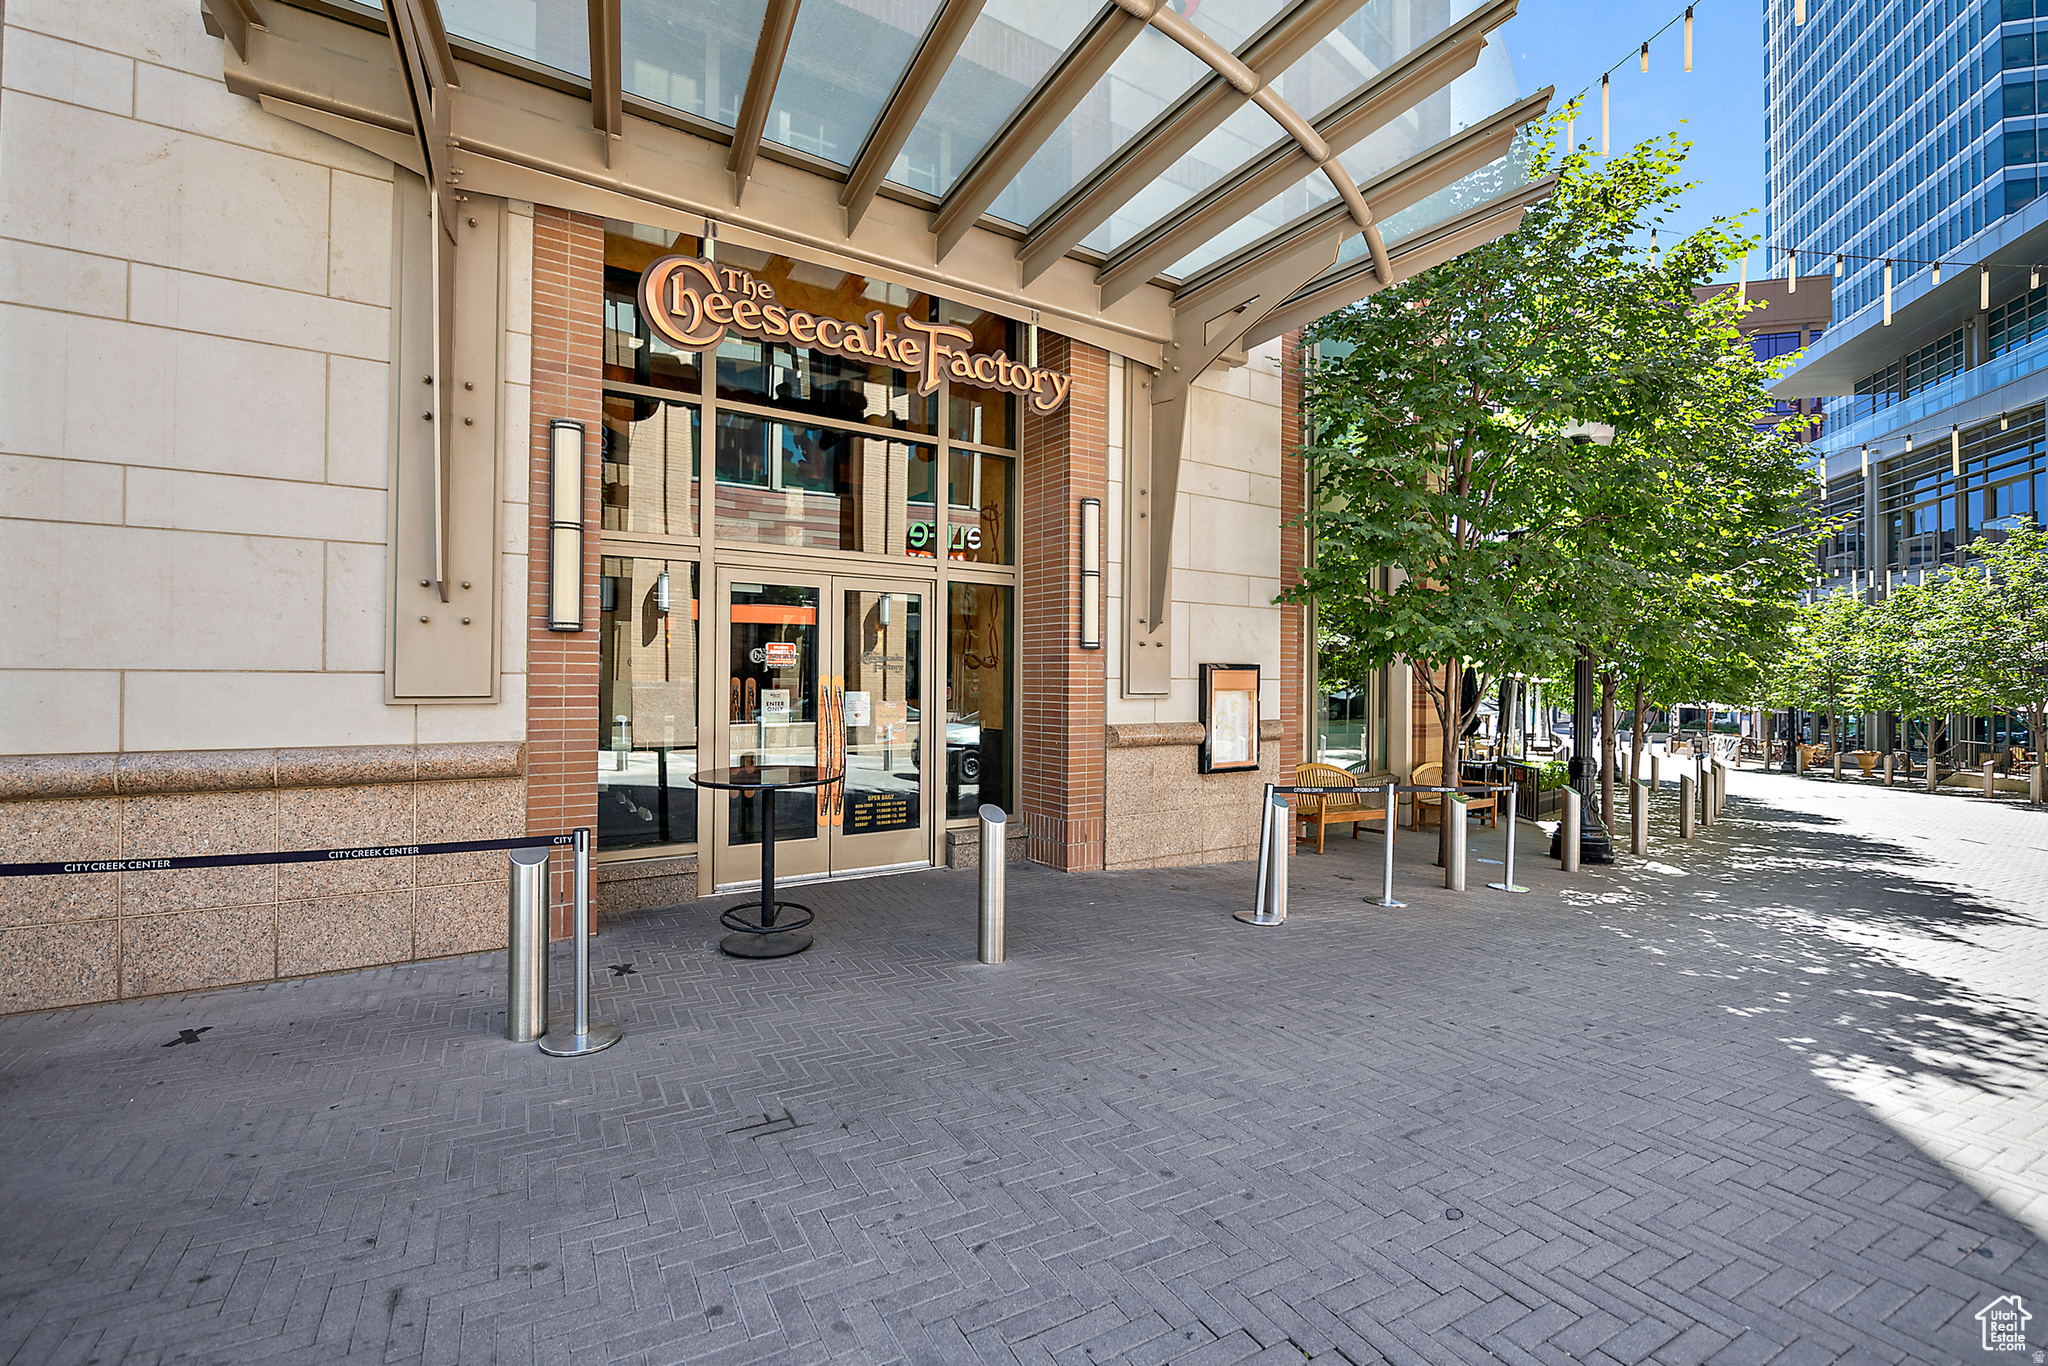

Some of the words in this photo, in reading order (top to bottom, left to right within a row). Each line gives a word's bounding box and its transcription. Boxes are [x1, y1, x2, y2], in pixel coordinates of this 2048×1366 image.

[721, 267, 773, 301] The
[645, 257, 922, 367] Cheesecake
[903, 315, 1072, 410] Factory
[553, 836, 573, 845] CITY
[328, 850, 351, 860] CITY
[351, 848, 382, 858] CREEK
[382, 846, 420, 856] CENTER
[64, 863, 90, 873] CITY
[91, 861, 127, 871] CREEK
[128, 859, 171, 870] CENTER
